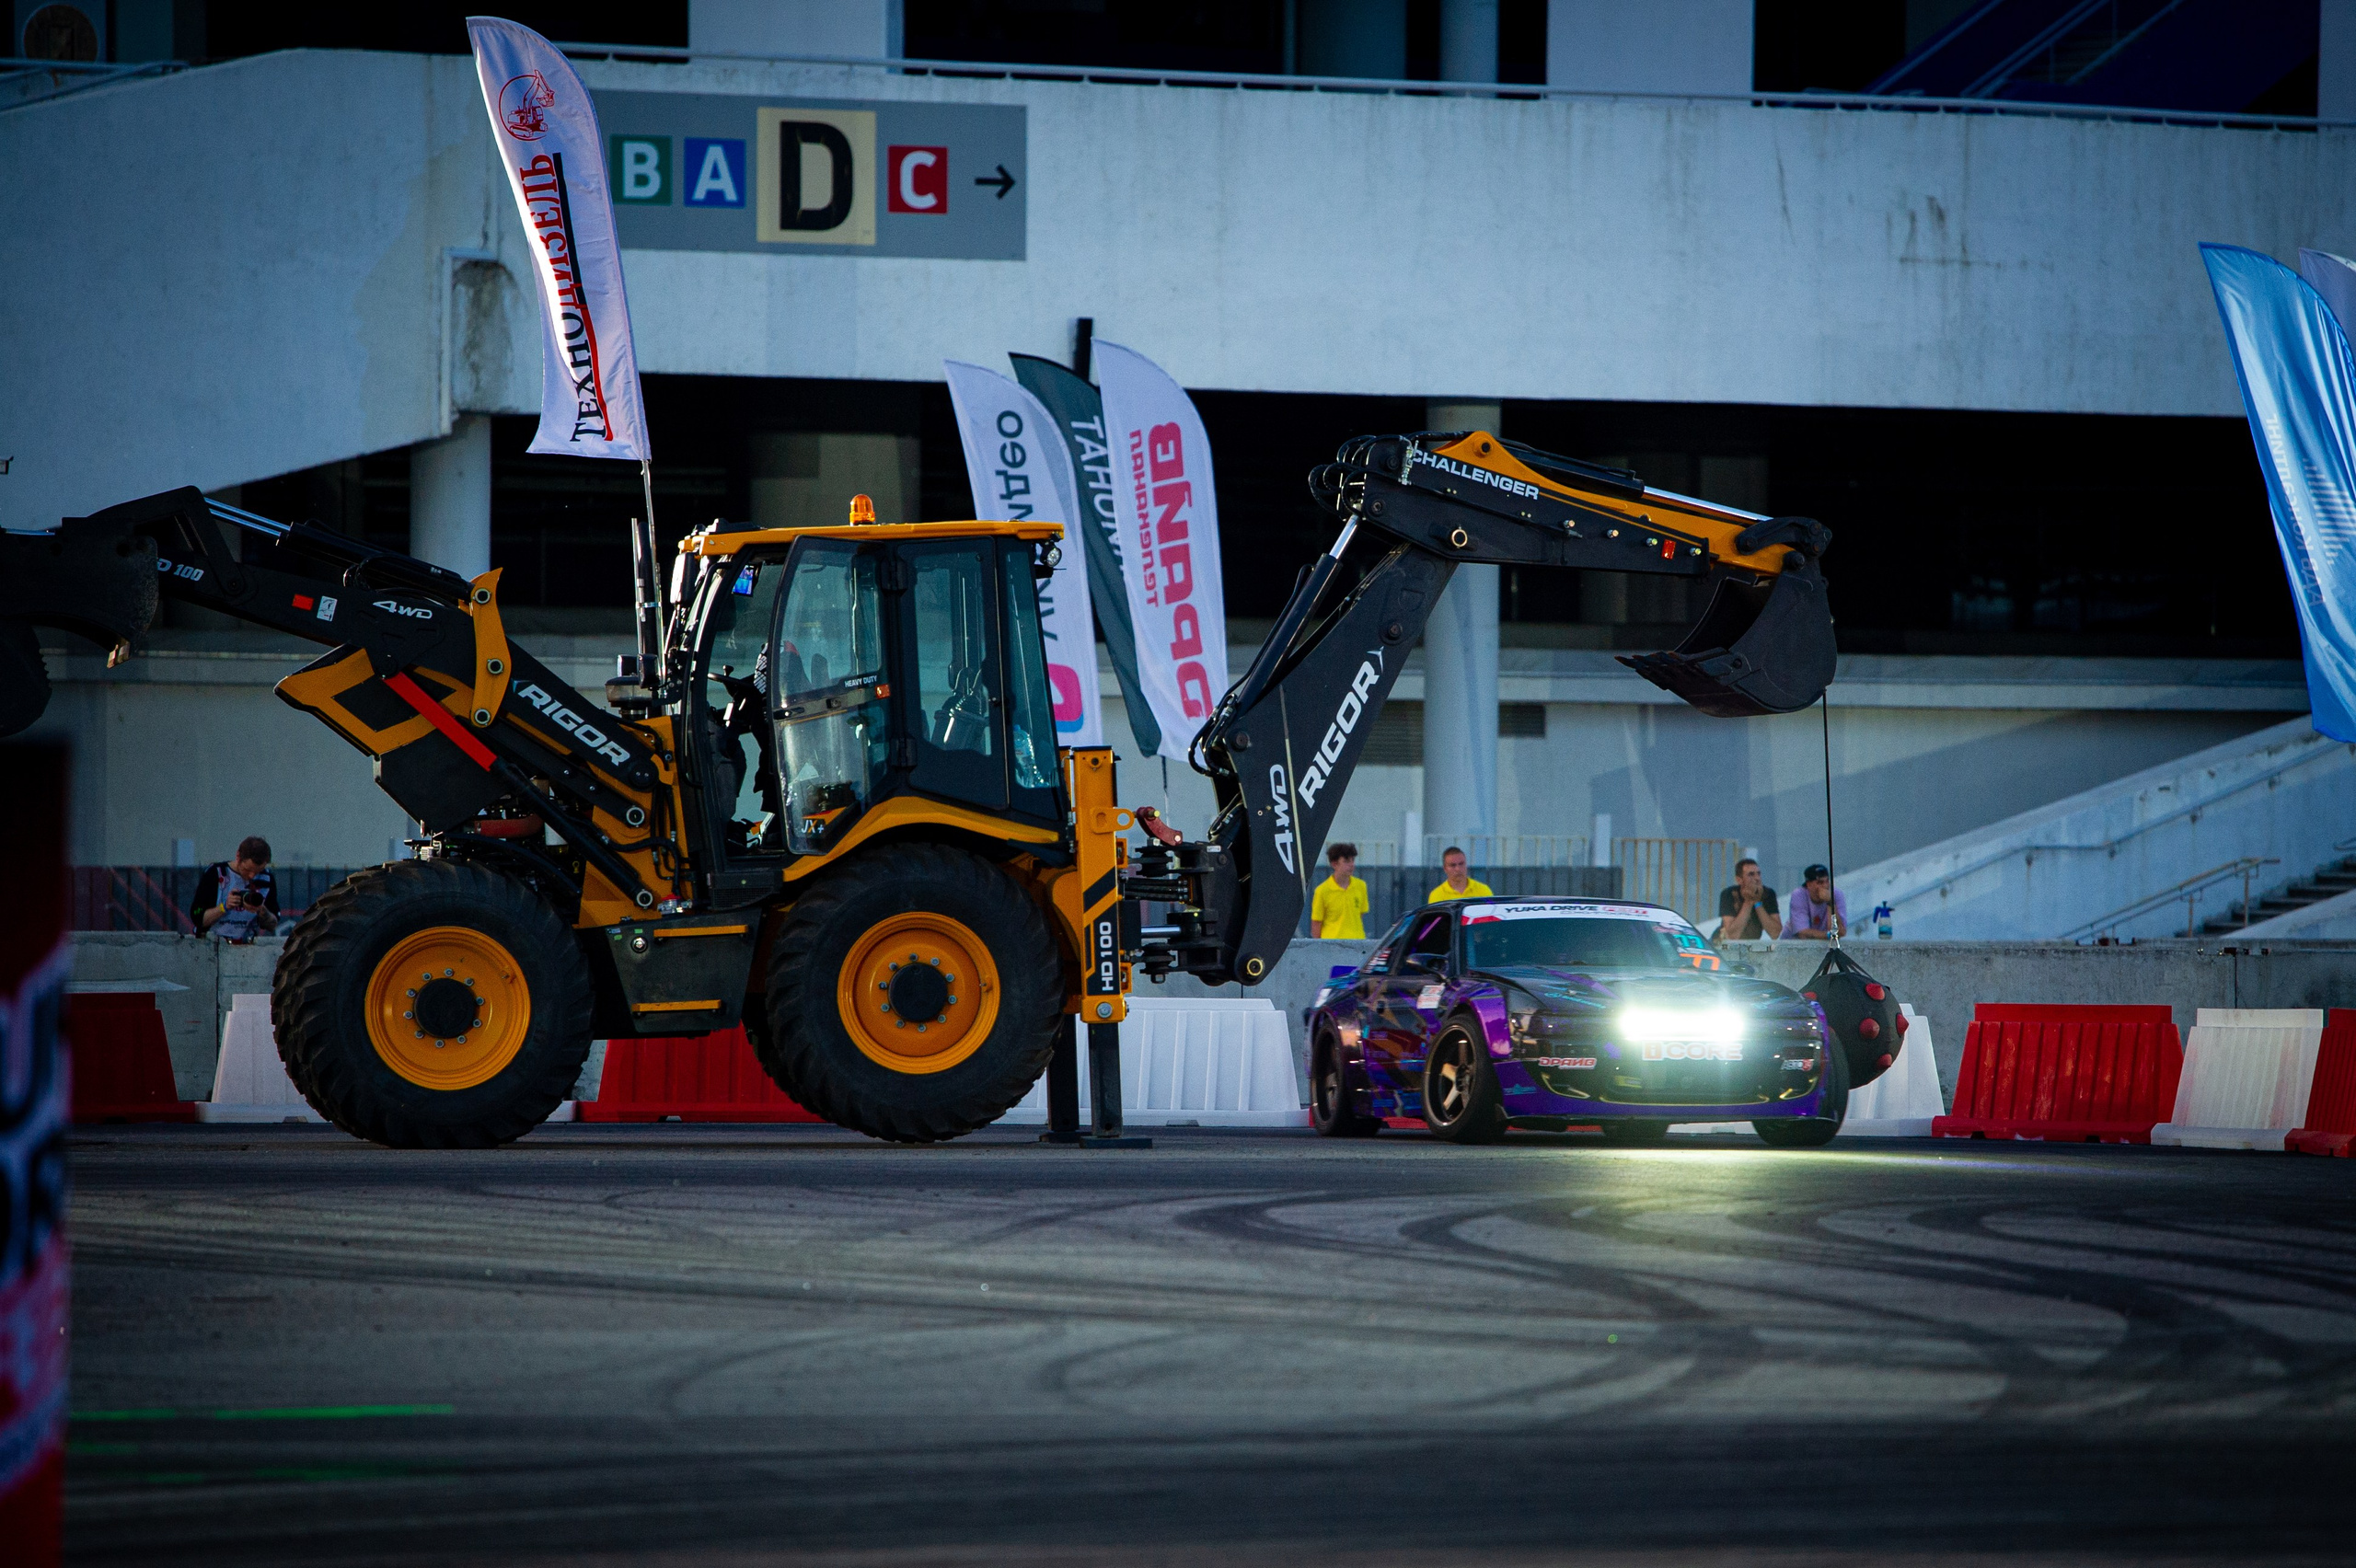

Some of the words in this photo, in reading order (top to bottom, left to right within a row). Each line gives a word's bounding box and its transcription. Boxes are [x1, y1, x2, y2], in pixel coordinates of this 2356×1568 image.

[622, 142, 662, 198] B
[692, 145, 737, 202] A
[779, 121, 854, 232] D
[898, 151, 937, 210] C
[1413, 449, 1539, 500] CHALLENGER
[173, 564, 204, 582] 100
[373, 600, 433, 619] 4WD
[844, 678, 862, 687] HEAVY
[863, 674, 877, 684] DUTY
[517, 684, 630, 767] RIGOR
[1298, 661, 1380, 809] RIGOR
[1269, 764, 1294, 874] 4WD
